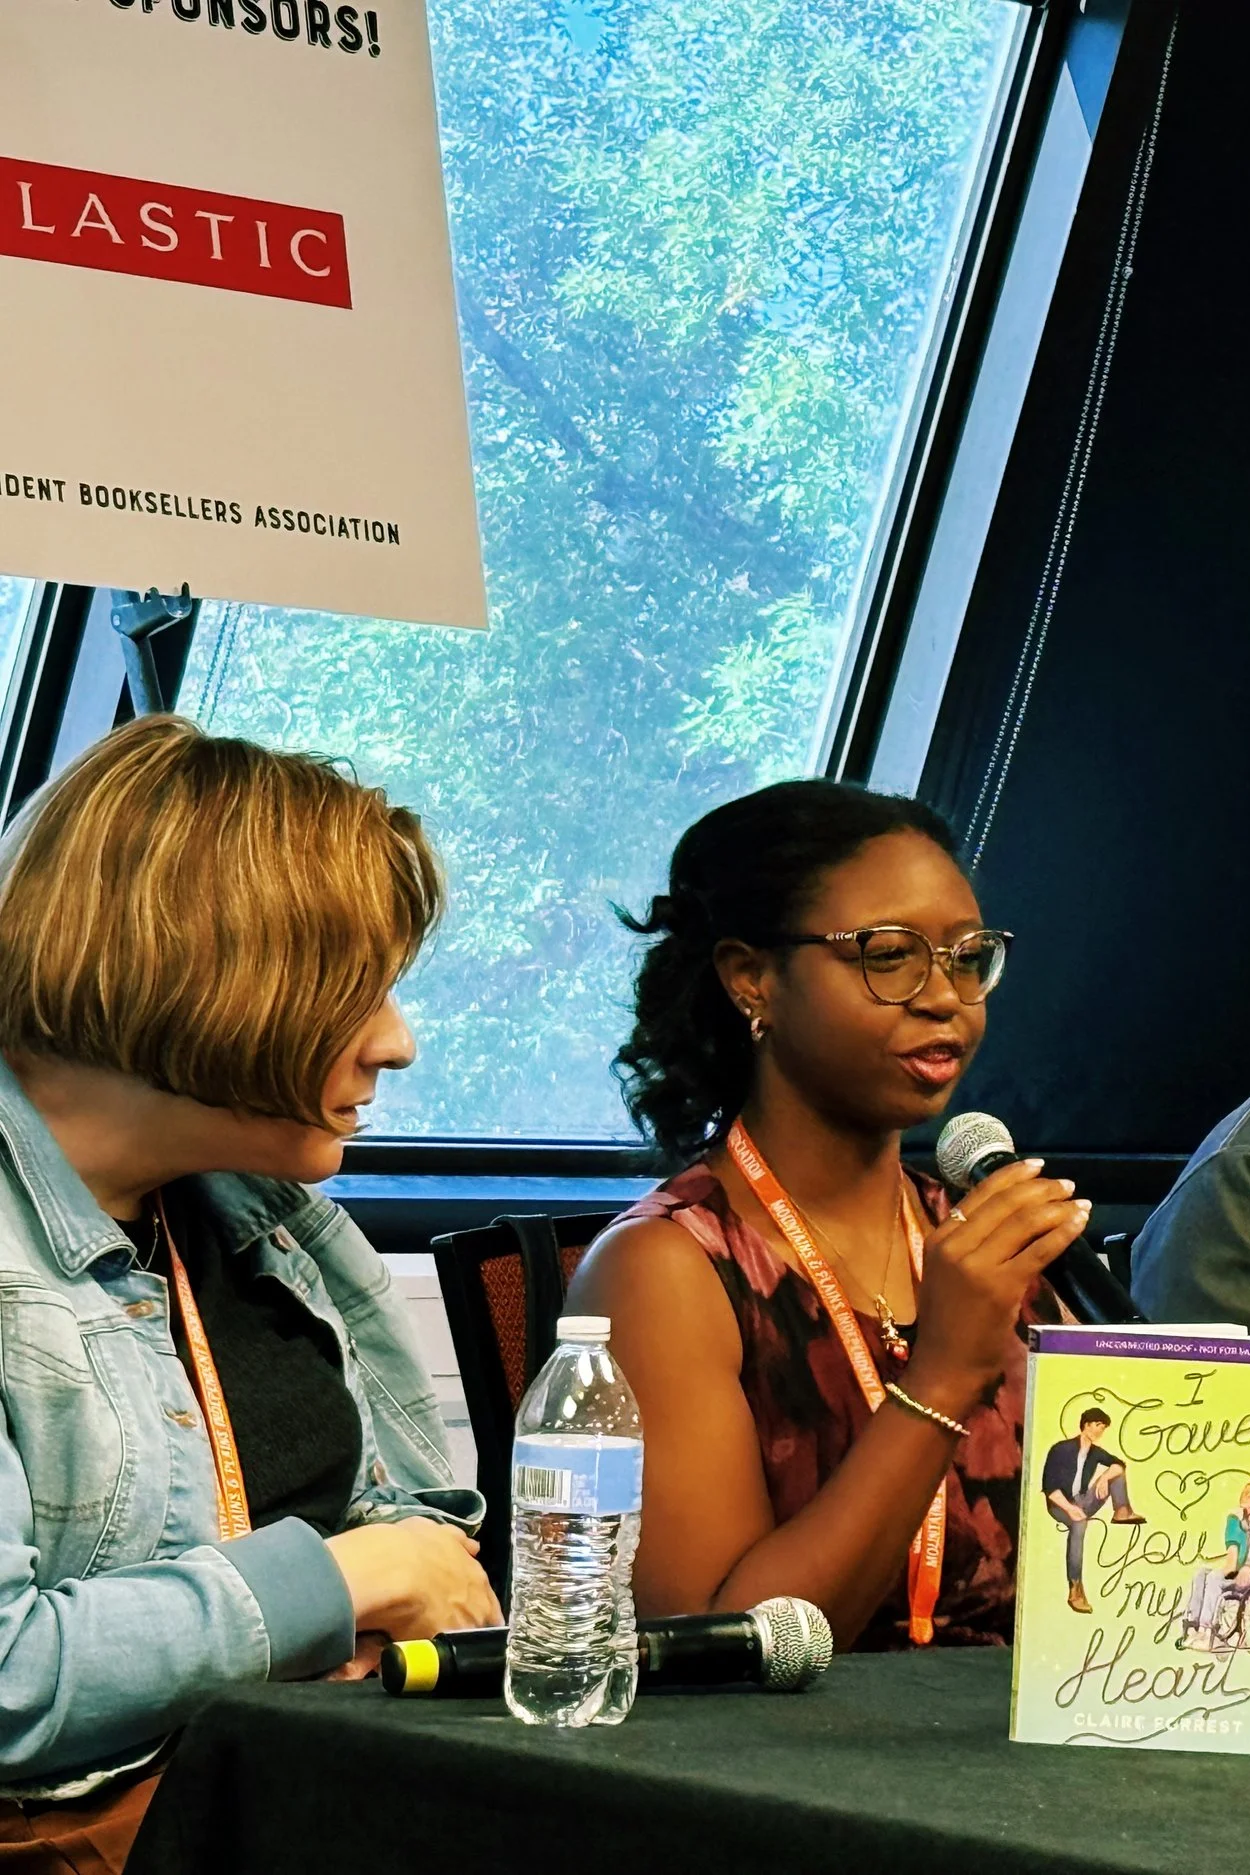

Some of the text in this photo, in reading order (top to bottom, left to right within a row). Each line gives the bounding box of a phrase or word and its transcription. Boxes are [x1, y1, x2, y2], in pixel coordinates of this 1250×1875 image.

[108, 0, 382, 58] NSORS!
[17, 181, 331, 277] LASTIC
[0, 474, 400, 545] DENT BOOKSELLERS ASSOCIATION
[770, 1198, 816, 1263] MOUNTAINS
[1175, 1369, 1218, 1407] I
[1097, 1520, 1228, 1597] You
[1074, 1713, 1243, 1734] CLAIRE FORREST
